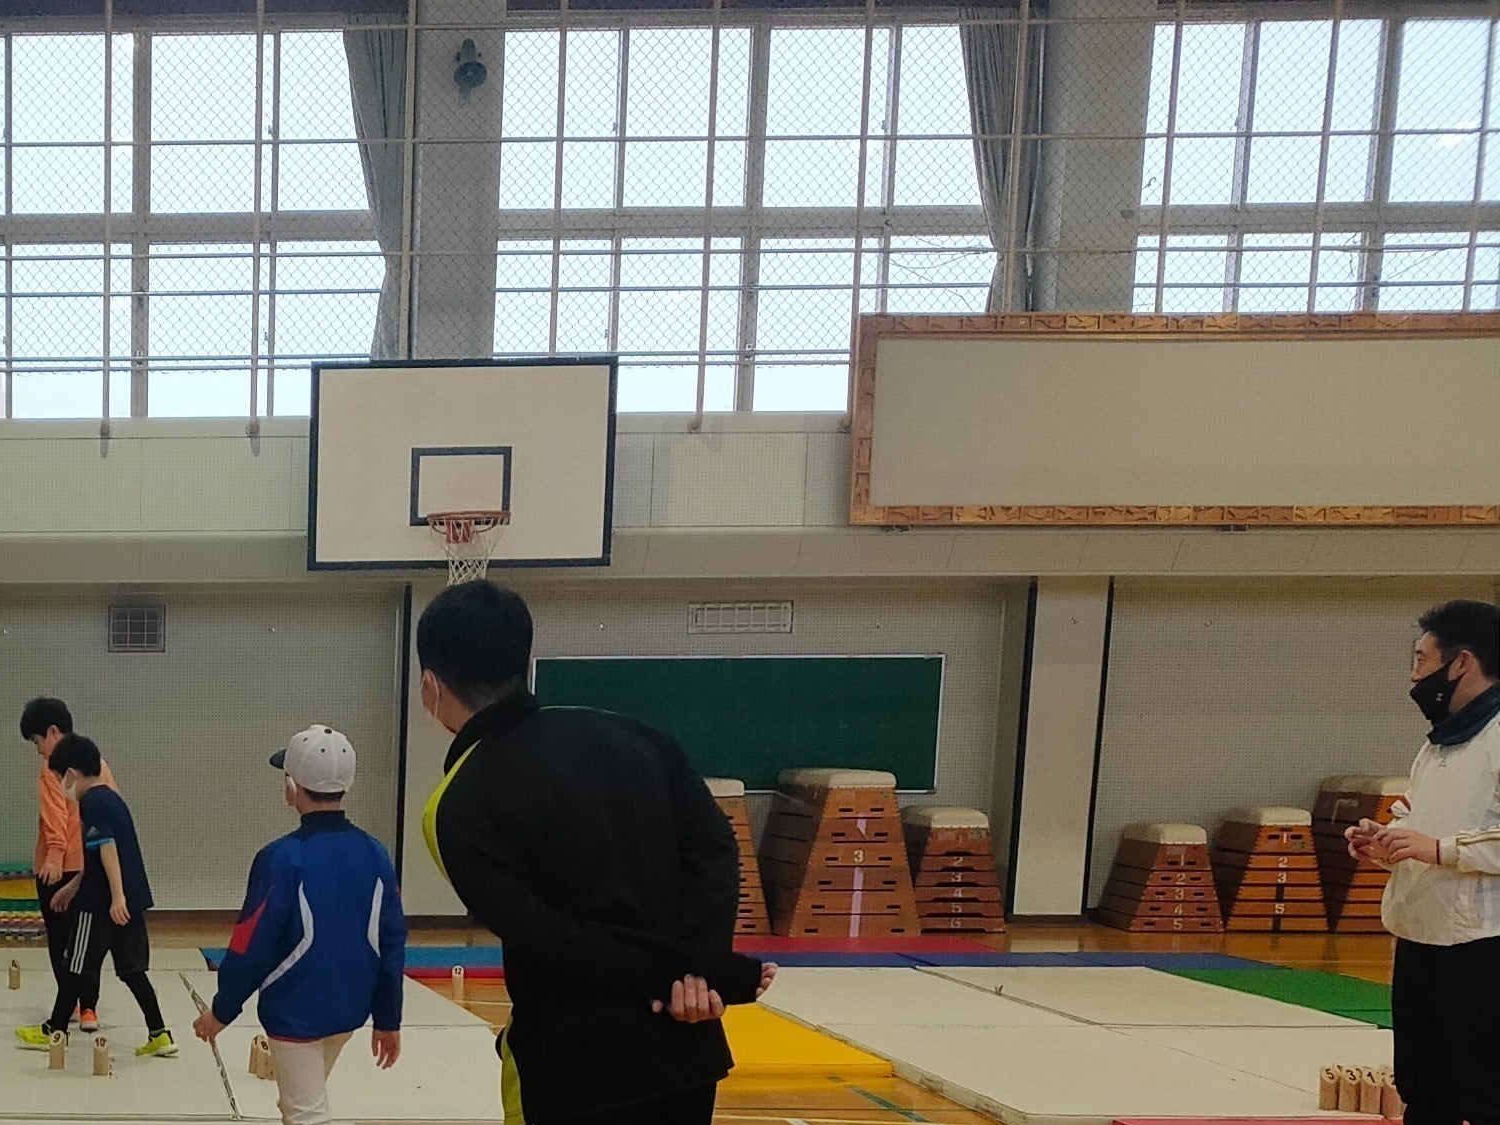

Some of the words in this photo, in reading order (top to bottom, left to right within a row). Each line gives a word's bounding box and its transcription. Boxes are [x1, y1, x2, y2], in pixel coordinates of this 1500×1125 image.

[853, 849, 864, 863] 3
[1277, 856, 1288, 869] 2
[1175, 872, 1186, 885] 2
[1276, 871, 1287, 884] 3
[1174, 888, 1185, 901] 3
[1173, 903, 1184, 916] 4
[1274, 903, 1285, 915] 5
[1172, 919, 1183, 931] 5
[454, 967, 462, 975] 12
[52, 1032, 61, 1043] 9
[95, 1036, 106, 1047] 10
[260, 1040, 269, 1051] 8
[1325, 1068, 1335, 1080] 5
[1345, 1069, 1357, 1081] 3
[1366, 1071, 1376, 1084] 1
